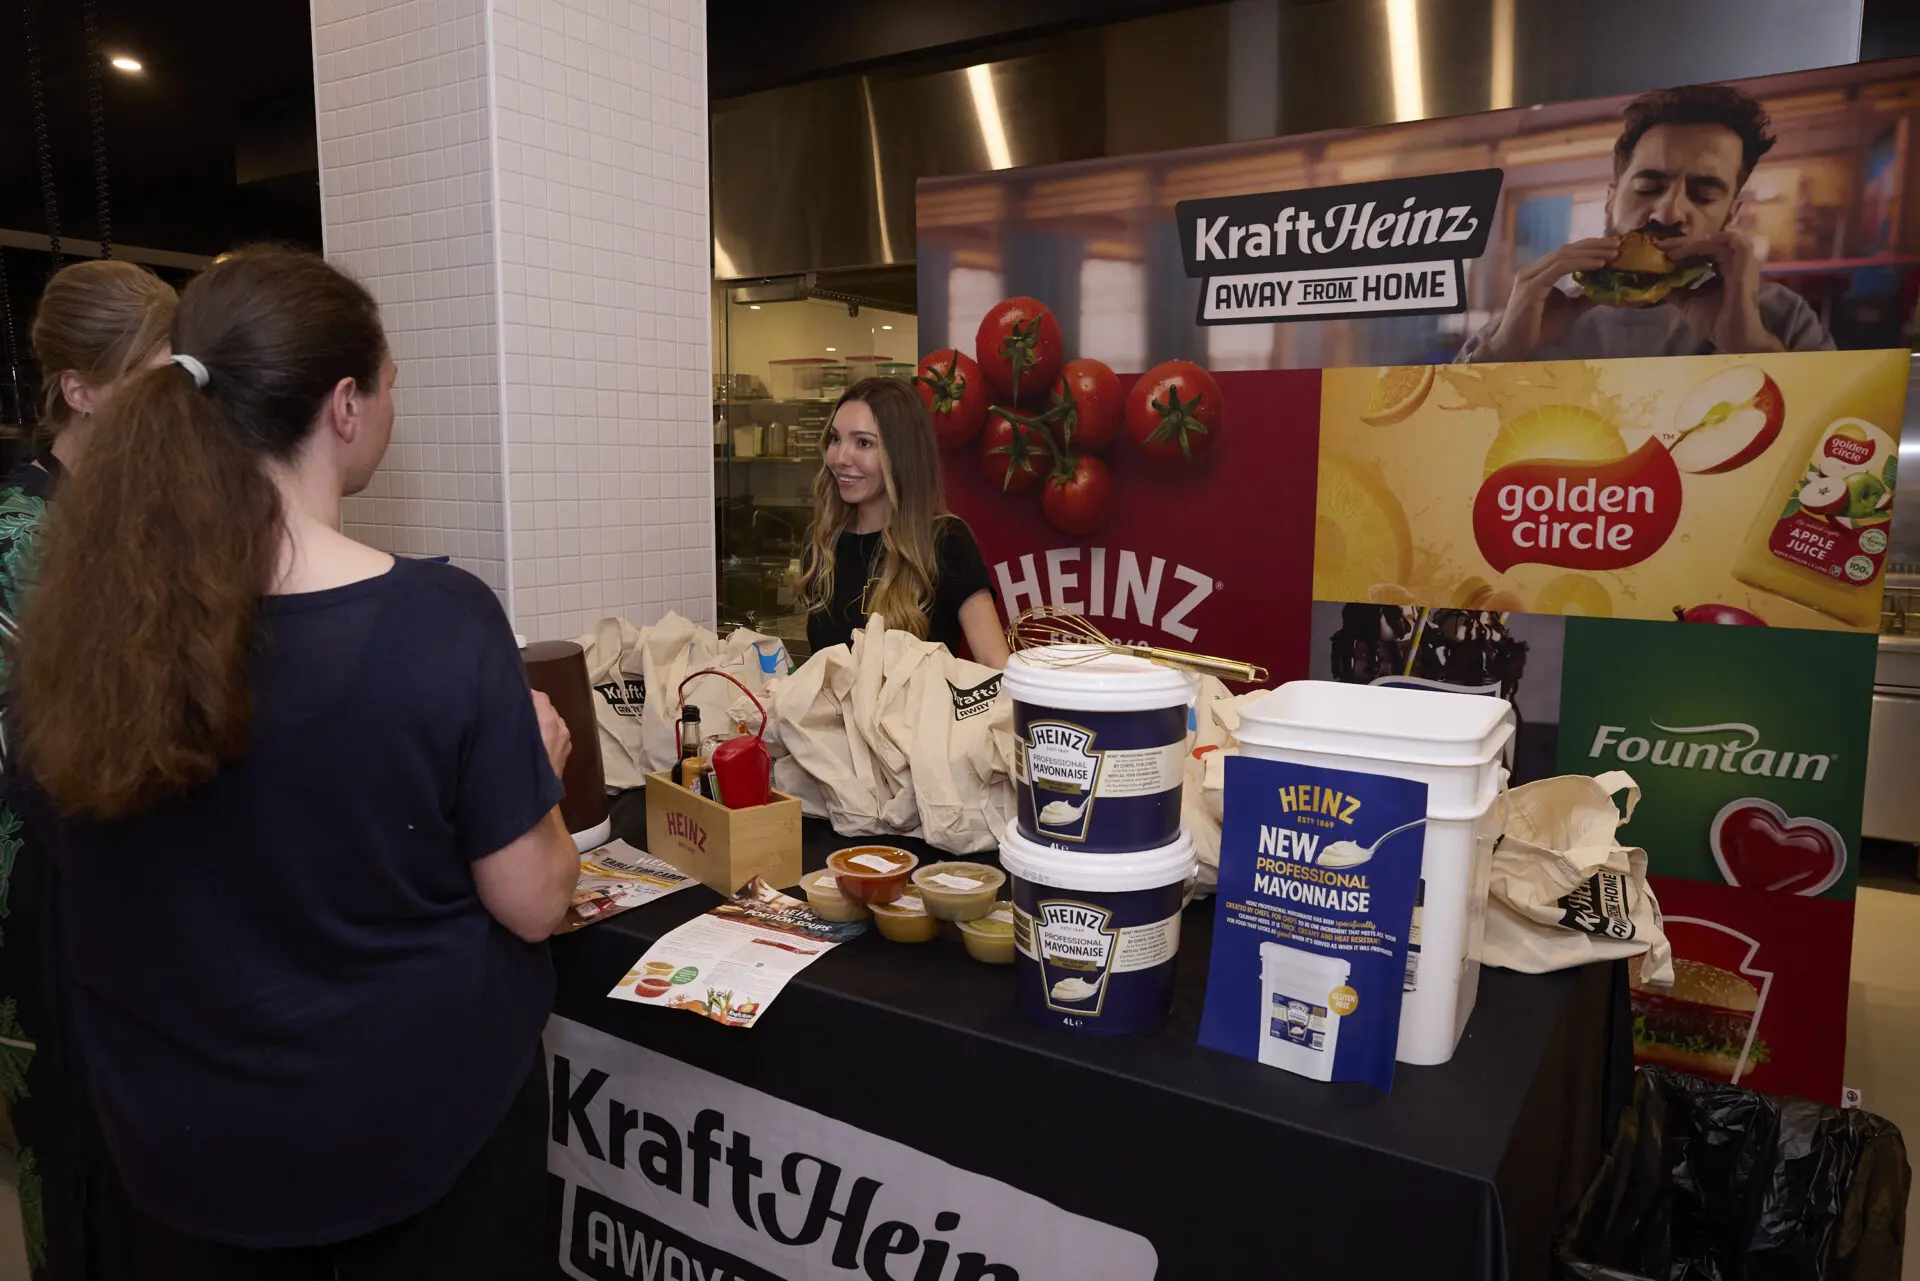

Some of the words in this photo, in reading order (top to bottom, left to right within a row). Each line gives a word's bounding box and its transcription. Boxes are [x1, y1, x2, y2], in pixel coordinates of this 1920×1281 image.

[1215, 280, 1293, 310] AWAY
[1303, 281, 1353, 301] FROM
[1362, 270, 1446, 301] HOME
[1831, 438, 1870, 457] golden
[1831, 447, 1862, 462] circle
[1497, 477, 1655, 522] golden
[1511, 514, 1634, 551] circle
[1790, 528, 1836, 551] APPLE
[1786, 538, 1828, 561] JUICE
[994, 547, 1214, 644] HEINZ
[959, 701, 989, 717] AWAY
[1035, 729, 1083, 751] HEINZ
[1588, 717, 1830, 781] Fountain
[1033, 753, 1087, 769] PROFESSIONAL
[1033, 762, 1089, 780] MAYONNAISE
[1278, 784, 1361, 825] HEINZ
[666, 812, 707, 854] HEINZ
[1316, 818, 1335, 829] 1869
[1258, 824, 1320, 864] NEW
[653, 870, 689, 882] CADDY
[1256, 857, 1370, 889] PROFESSIONAL
[1253, 872, 1371, 913] MAYONNAISE
[744, 909, 796, 924] PORTION
[793, 920, 833, 932] SOUPS
[778, 908, 817, 921] HEINZ
[1048, 909, 1099, 930] HEINZ
[1335, 920, 1376, 930] specifically
[1044, 932, 1103, 947] PROFESSIONAL
[1044, 941, 1104, 957] MAYONNAISE
[1331, 992, 1355, 1003] GLUTEN
